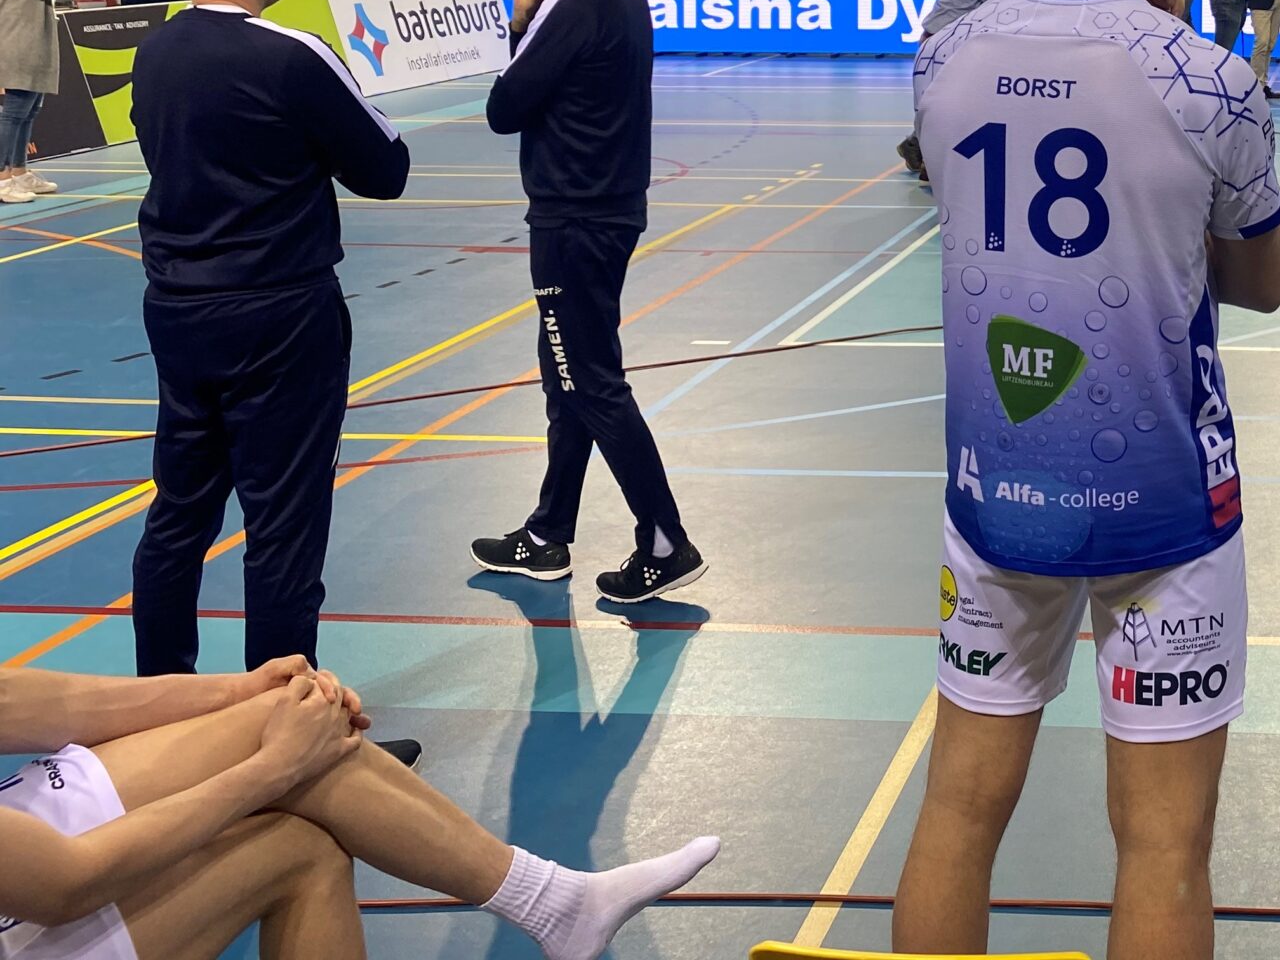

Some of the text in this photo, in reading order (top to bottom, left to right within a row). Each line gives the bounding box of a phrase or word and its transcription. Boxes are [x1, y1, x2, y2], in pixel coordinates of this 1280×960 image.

[406, 46, 482, 72] installatietechniek
[995, 76, 1077, 100] BORST
[951, 121, 1110, 259] 18
[1001, 343, 1054, 379] MF
[957, 614, 1004, 629] management
[1160, 611, 1224, 637] MTN
[1166, 631, 1221, 644] accountants
[1173, 640, 1216, 651] adviseurs
[1111, 661, 1229, 708] HEPRO
